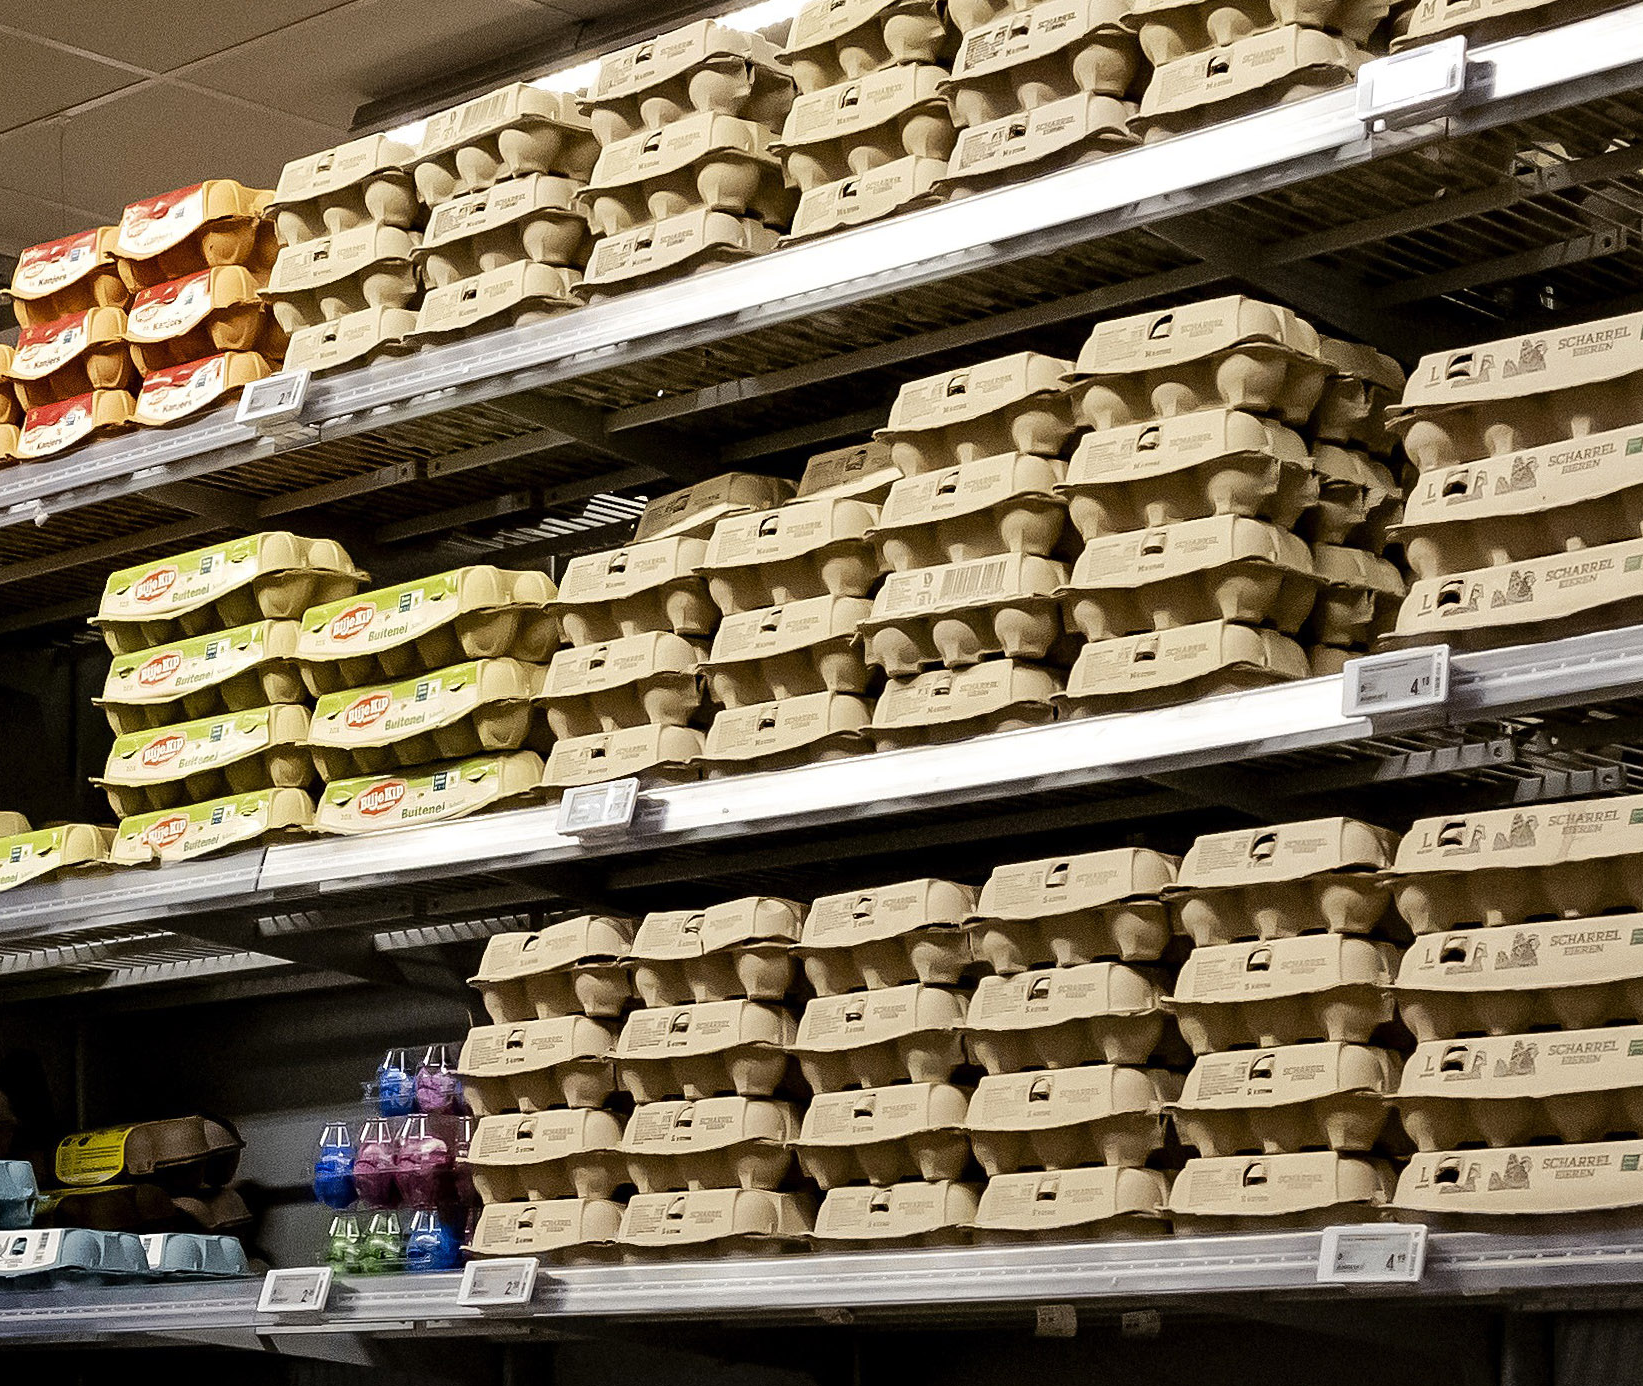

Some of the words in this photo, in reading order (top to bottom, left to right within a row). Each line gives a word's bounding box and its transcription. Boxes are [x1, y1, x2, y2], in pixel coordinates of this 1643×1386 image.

[1557, 326, 1632, 351] SCHARREL
[1430, 369, 1440, 383] L
[1547, 443, 1617, 468] SCHARREL
[1426, 484, 1435, 498] L
[1545, 557, 1615, 582] SCHARREL
[172, 585, 209, 602] Buitenei
[1422, 594, 1431, 609] L
[368, 626, 408, 642] Buitenei
[175, 670, 214, 686] Buitenei
[385, 713, 425, 730] Buitenei
[402, 802, 446, 818] Buitenei
[1548, 810, 1620, 826] SCHARREL
[183, 835, 220, 853] Buitenei
[1422, 833, 1431, 848] L
[1550, 930, 1622, 946] SCHARREL
[1424, 949, 1433, 964] L
[1548, 1040, 1619, 1056] SCHARREL
[1424, 1056, 1434, 1071] L
[1542, 1155, 1612, 1169] SCHARREL
[1420, 1167, 1429, 1182] L
